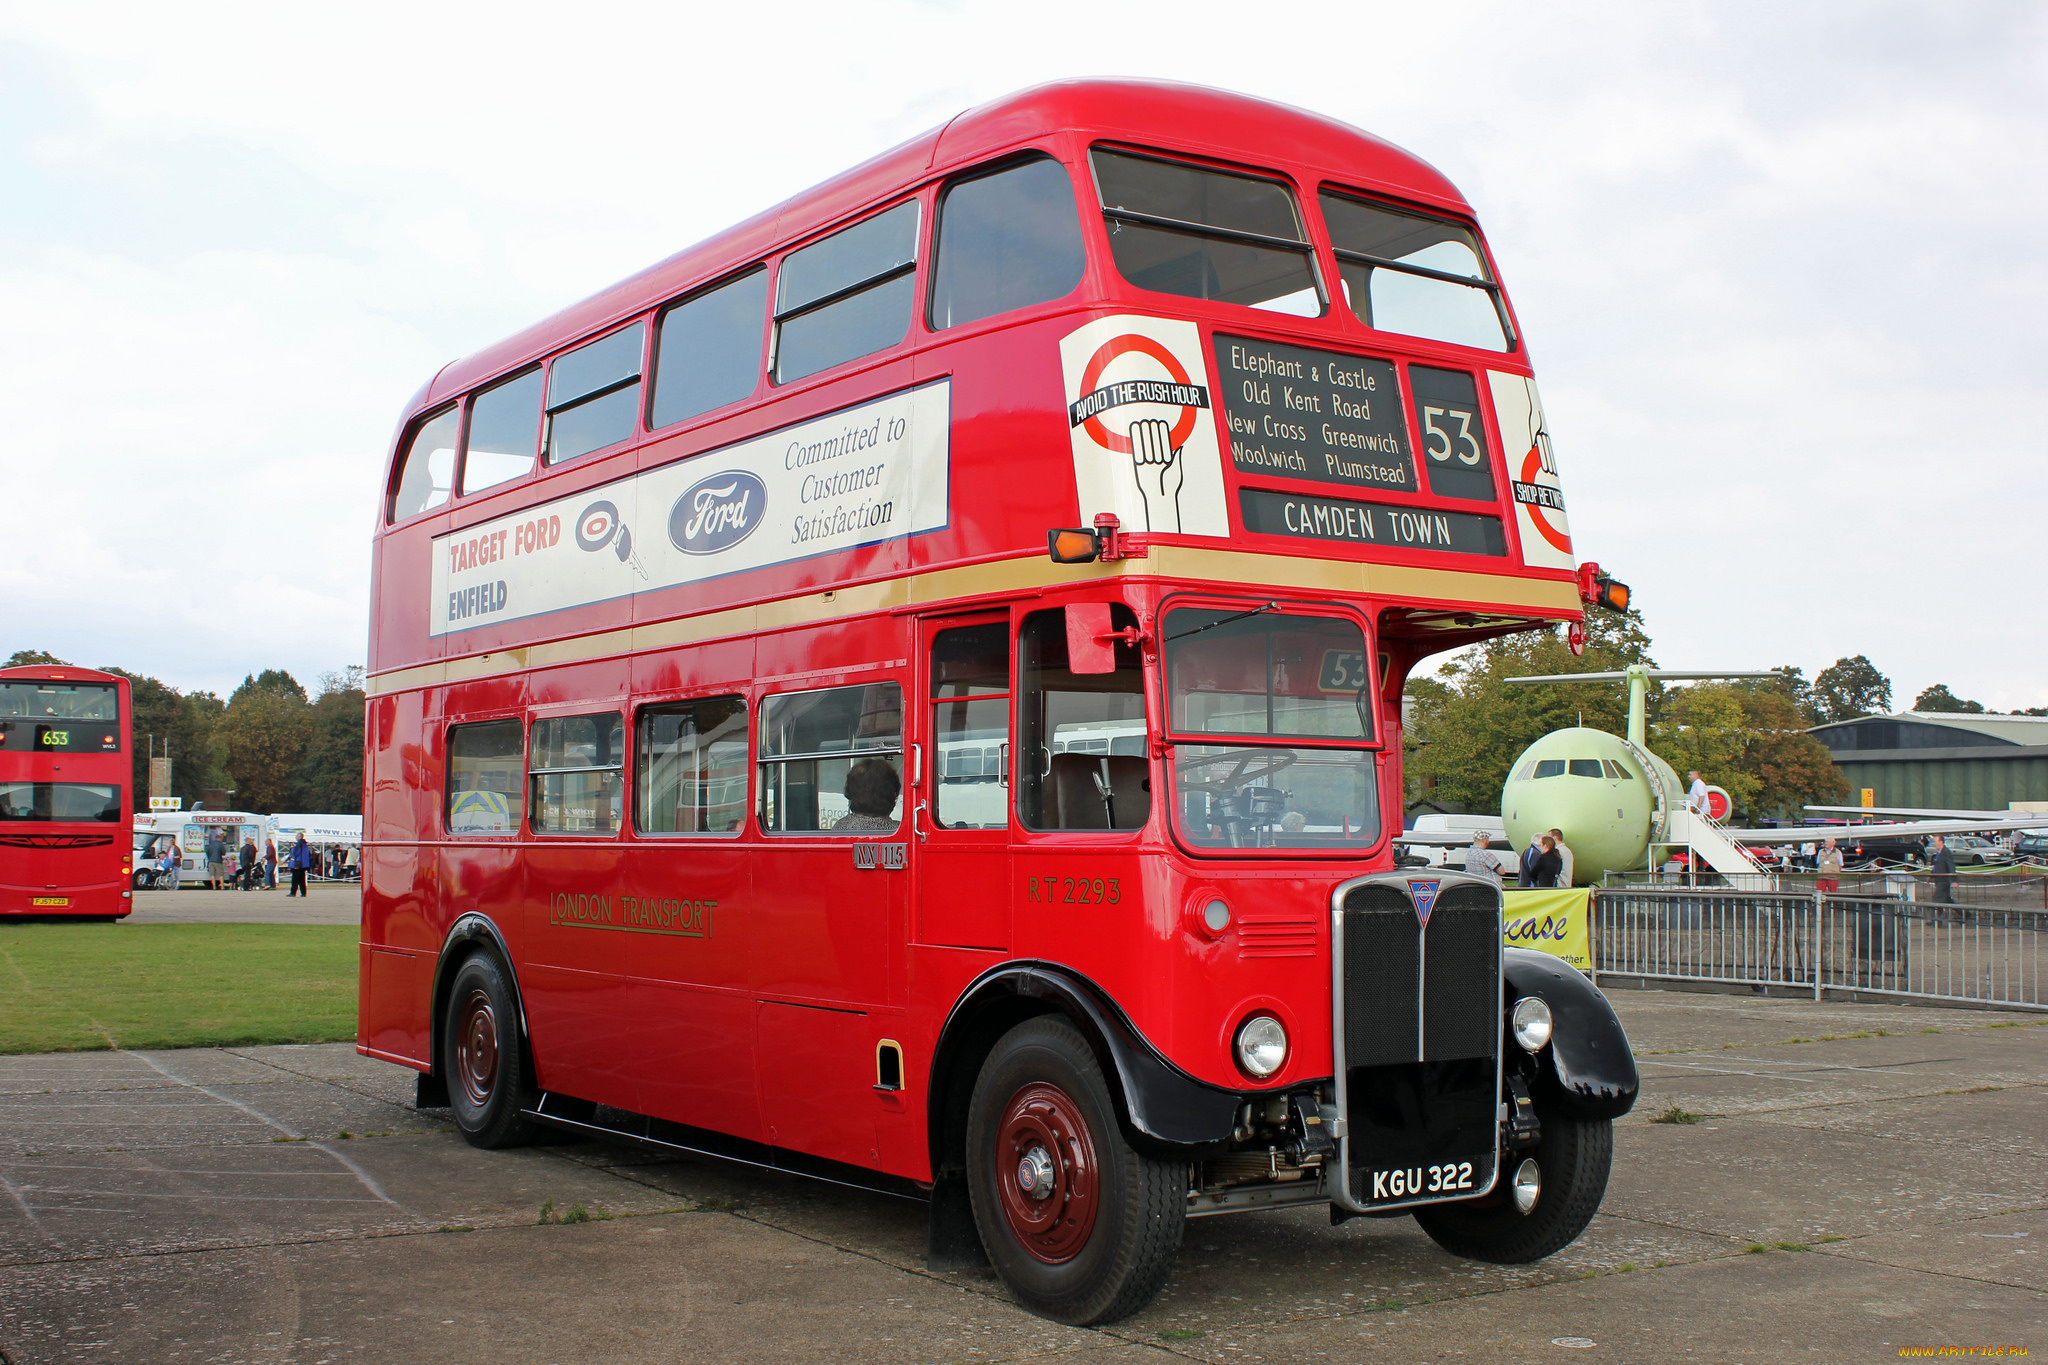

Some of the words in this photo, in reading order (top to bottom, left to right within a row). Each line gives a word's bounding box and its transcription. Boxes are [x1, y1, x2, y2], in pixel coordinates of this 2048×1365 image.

[1231, 345, 1304, 379] Elephant
[1311, 366, 1320, 382] &
[1328, 362, 1376, 392] Castle
[1076, 390, 1108, 423] AVOID
[1110, 383, 1137, 405] THE
[1137, 382, 1171, 402] RUSH
[1171, 384, 1202, 406] HOUR
[1243, 380, 1271, 406] Old
[1284, 386, 1321, 413] Kent
[1332, 393, 1371, 420] Road
[785, 417, 880, 471] Committed
[887, 416, 905, 442] to
[1224, 409, 1256, 435] New
[1264, 414, 1306, 442] Cross
[1322, 423, 1399, 454] Greenwich
[1424, 406, 1481, 465] 53
[801, 463, 885, 504] Customer
[1230, 441, 1306, 472] Woolwich
[1325, 453, 1406, 484] Plumstead
[685, 481, 750, 540] Ford
[1516, 483, 1537, 503] SHOP
[791, 498, 893, 545] Satisfaction
[1284, 502, 1375, 540] CAMDEN
[1387, 512, 1452, 546] TOWN
[450, 529, 507, 574] TARGET
[515, 515, 560, 556] FORD
[448, 579, 507, 621] ENFIELD
[43, 731, 69, 746] 653
[858, 845, 875, 865] NX
[884, 846, 904, 865] 115
[1029, 877, 1057, 903] RT
[1063, 877, 1121, 905] 2293
[550, 892, 612, 926] LONDON
[620, 896, 719, 939] TRANSPORT
[1373, 1167, 1422, 1199] KGU
[1427, 1161, 1473, 1192] 322
